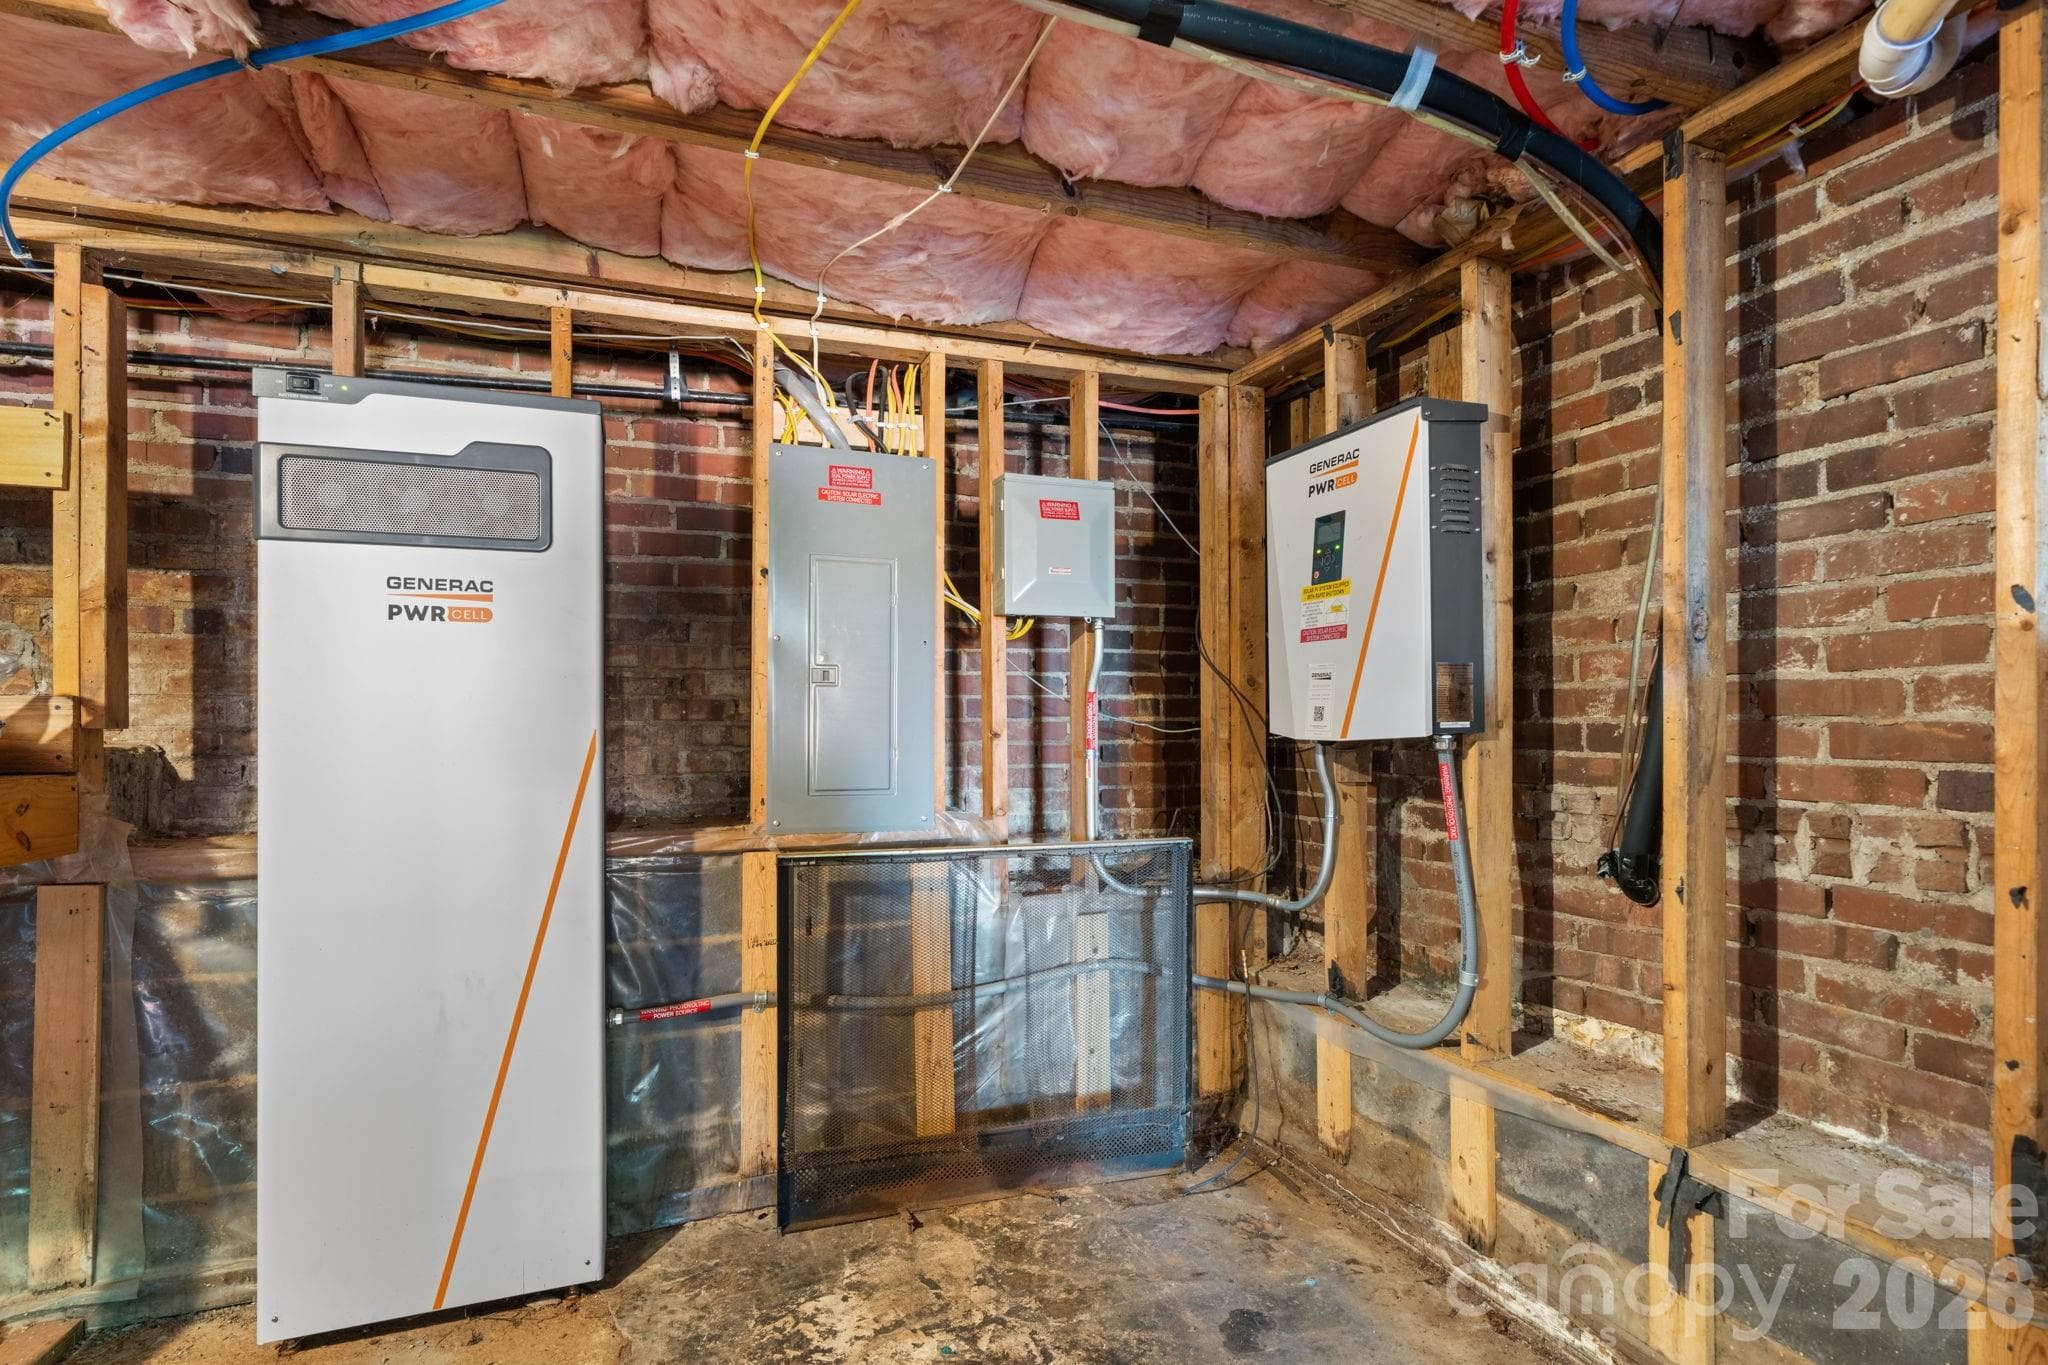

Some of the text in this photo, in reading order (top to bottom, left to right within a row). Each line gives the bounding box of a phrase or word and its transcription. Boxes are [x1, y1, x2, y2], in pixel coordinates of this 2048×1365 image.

[1309, 448, 1360, 475] GENERAC
[837, 467, 866, 476] WARNING
[858, 492, 879, 500] ELECTRIC
[386, 576, 494, 593] GENERAC
[1445, 795, 1459, 840] PHOTOVOLTAIC
[669, 1000, 710, 1011] PHOTOVOLTAIC
[653, 1008, 698, 1020] POWER SOURCE
